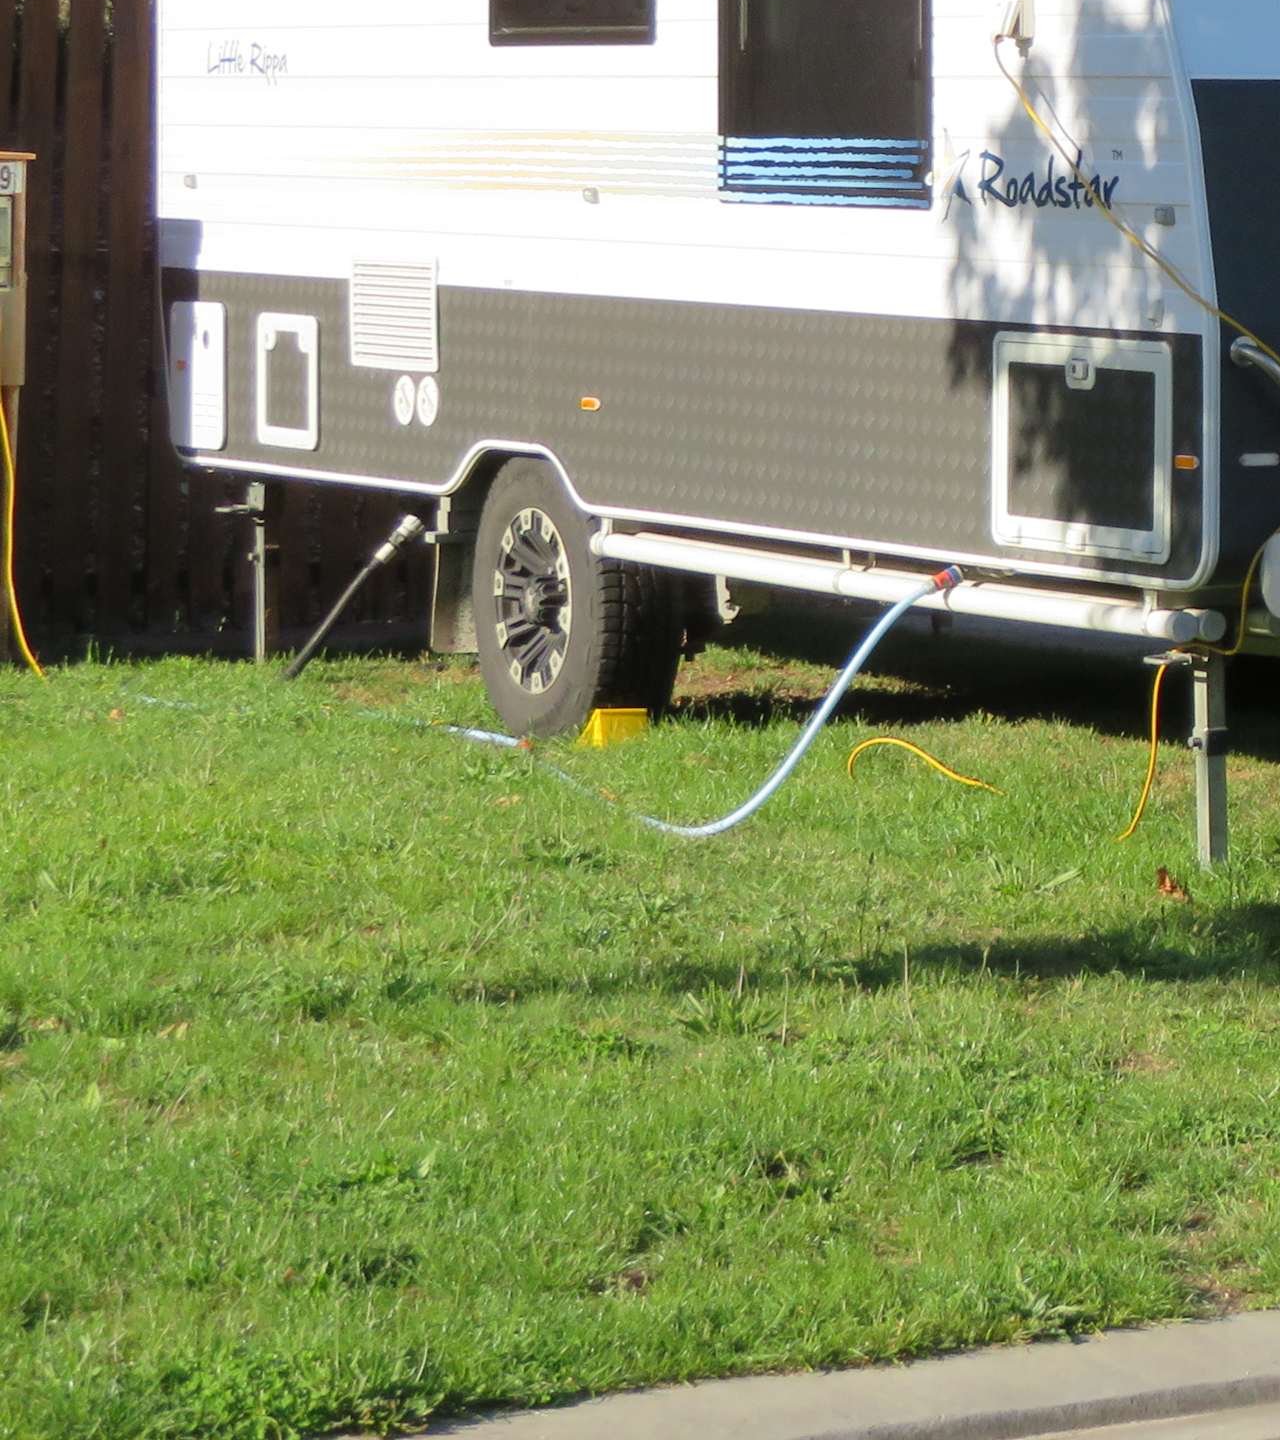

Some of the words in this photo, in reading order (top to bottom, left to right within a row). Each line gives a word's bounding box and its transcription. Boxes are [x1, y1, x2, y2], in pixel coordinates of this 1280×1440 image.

[208, 40, 243, 74] Little
[250, 42, 288, 86] Rippa
[978, 150, 1119, 209] Roadstar
